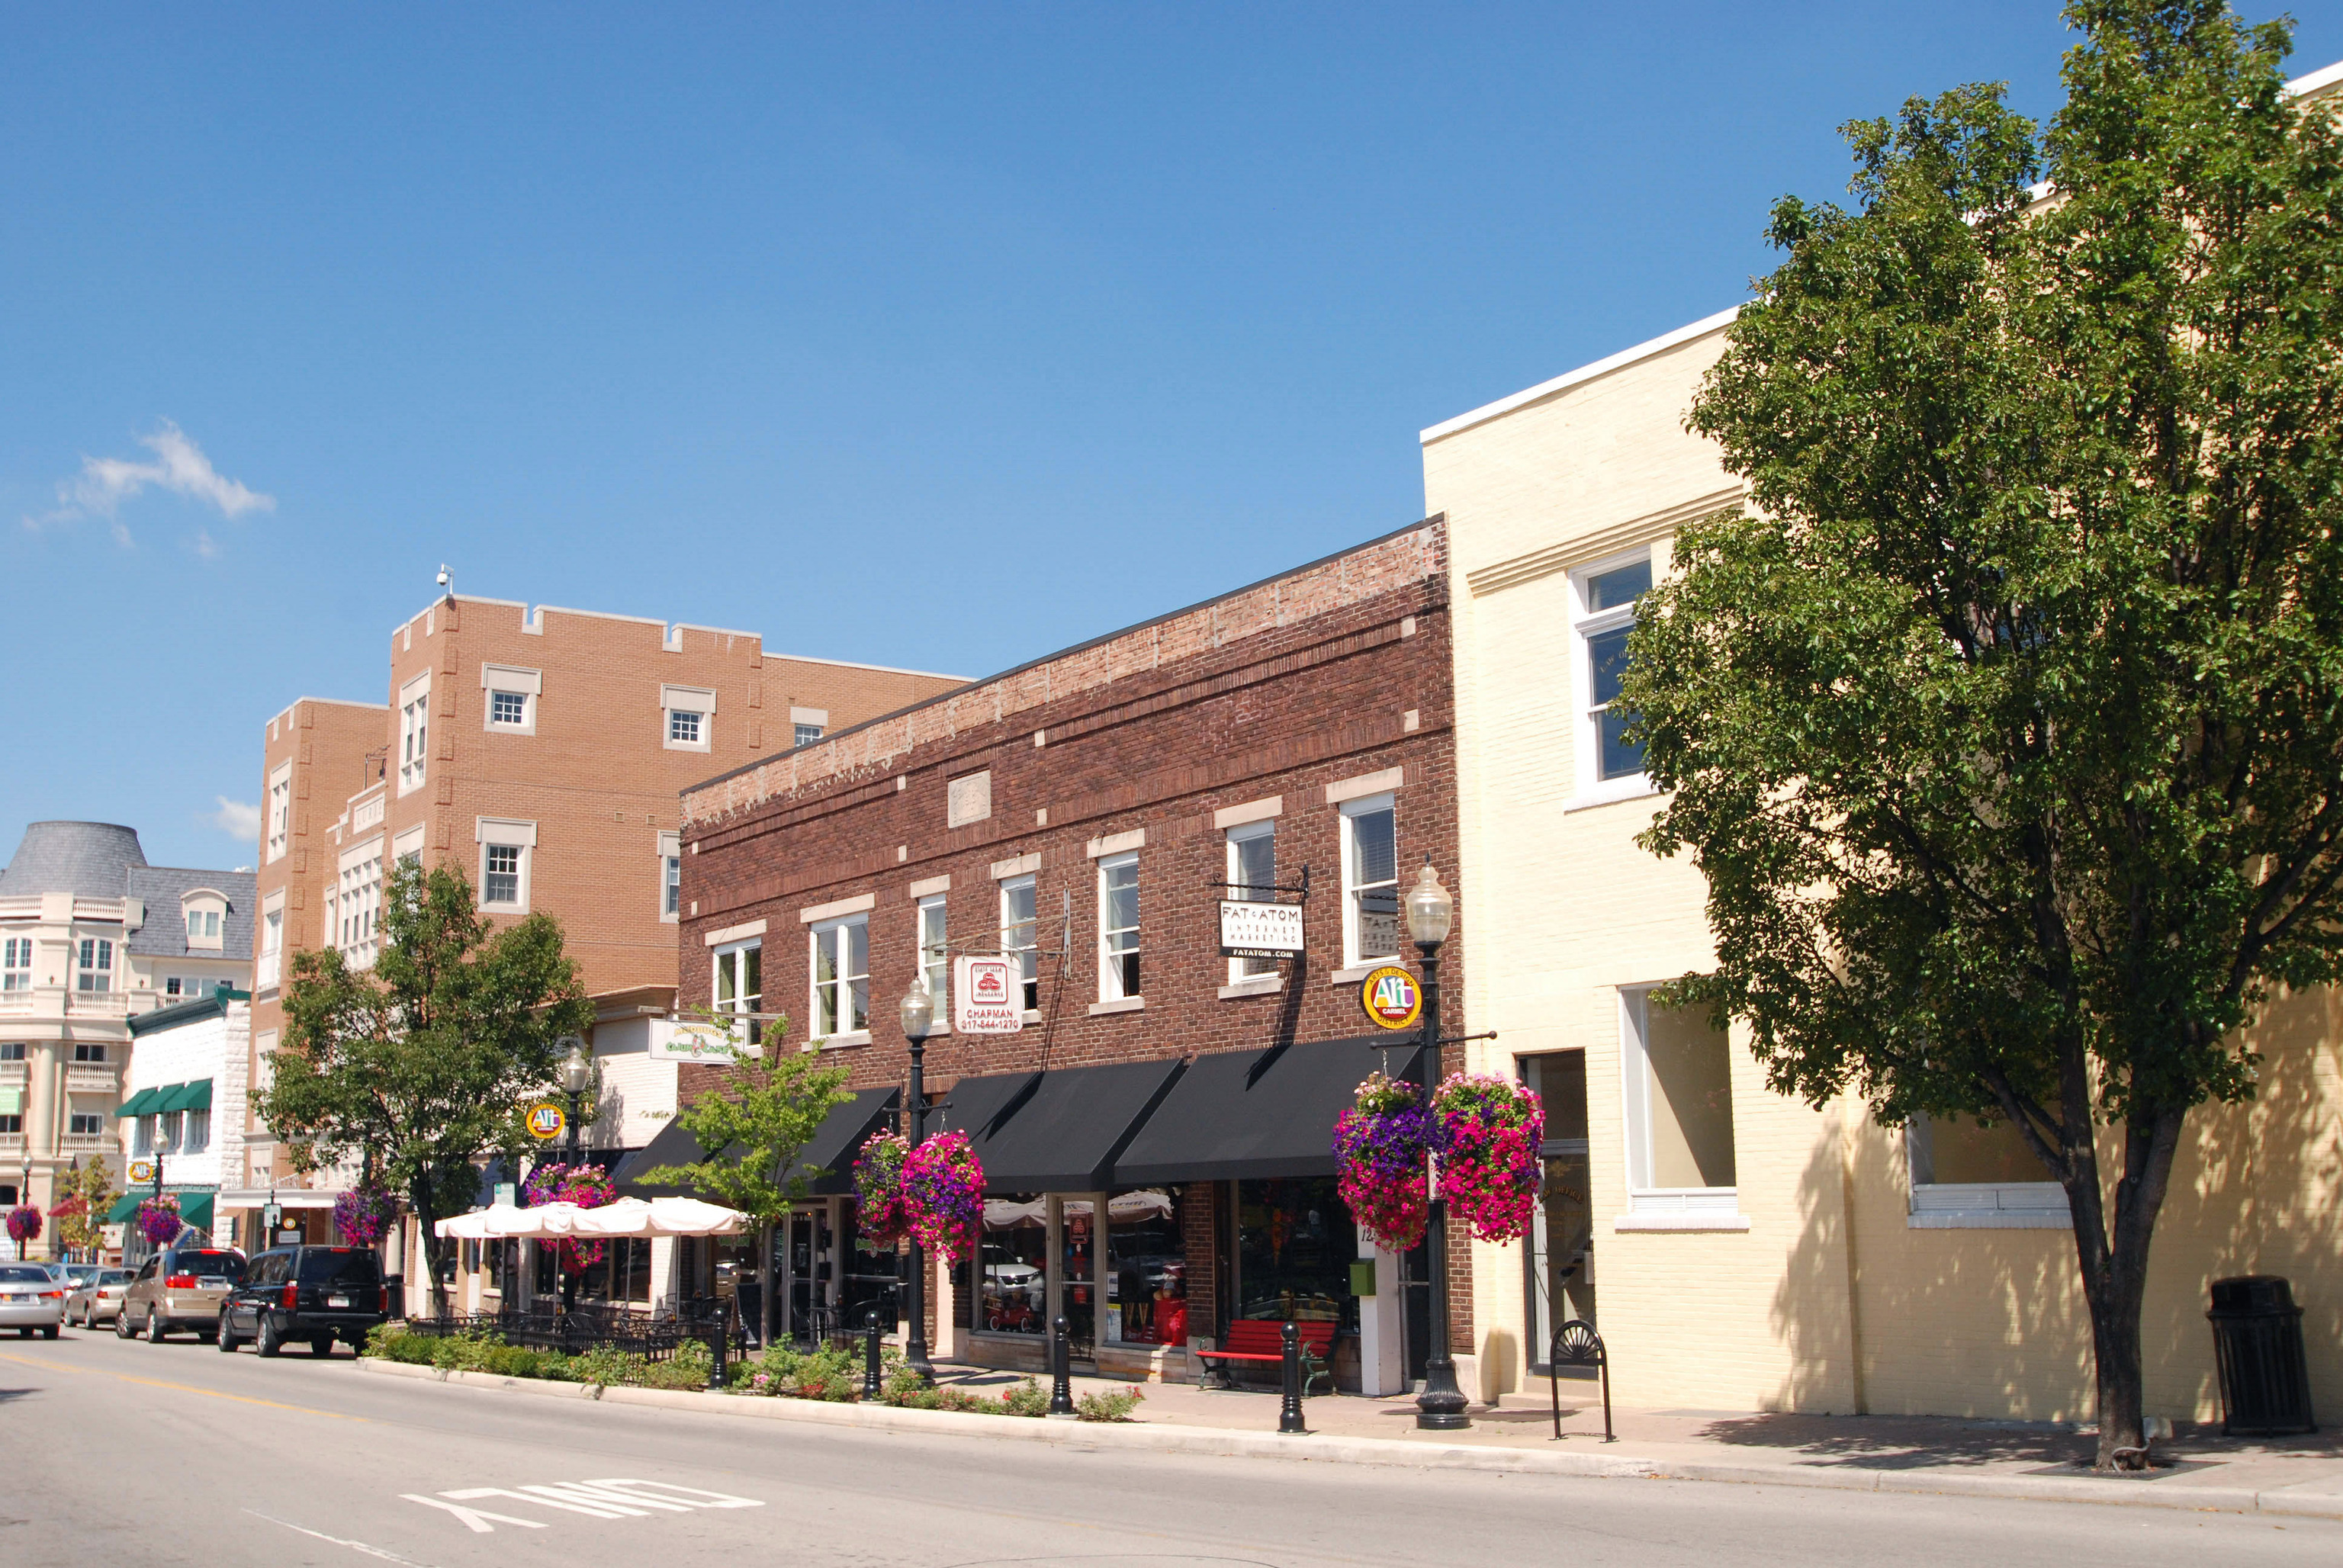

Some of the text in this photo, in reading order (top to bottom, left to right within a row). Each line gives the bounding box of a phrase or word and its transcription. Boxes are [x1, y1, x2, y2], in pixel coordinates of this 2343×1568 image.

[1222, 906, 1249, 920] FAT
[1229, 924, 1296, 934] INTERNET
[1230, 933, 1296, 943] MARKETING
[1233, 949, 1294, 958] FATATOM.COM
[1369, 969, 1384, 985] ARTS
[1390, 969, 1415, 987] DESIGN
[1373, 977, 1413, 1008] Art
[966, 1009, 1013, 1019] CHAPMAN
[1377, 1015, 1409, 1026] DISTRICT
[1361, 1228, 1375, 1242] 12
